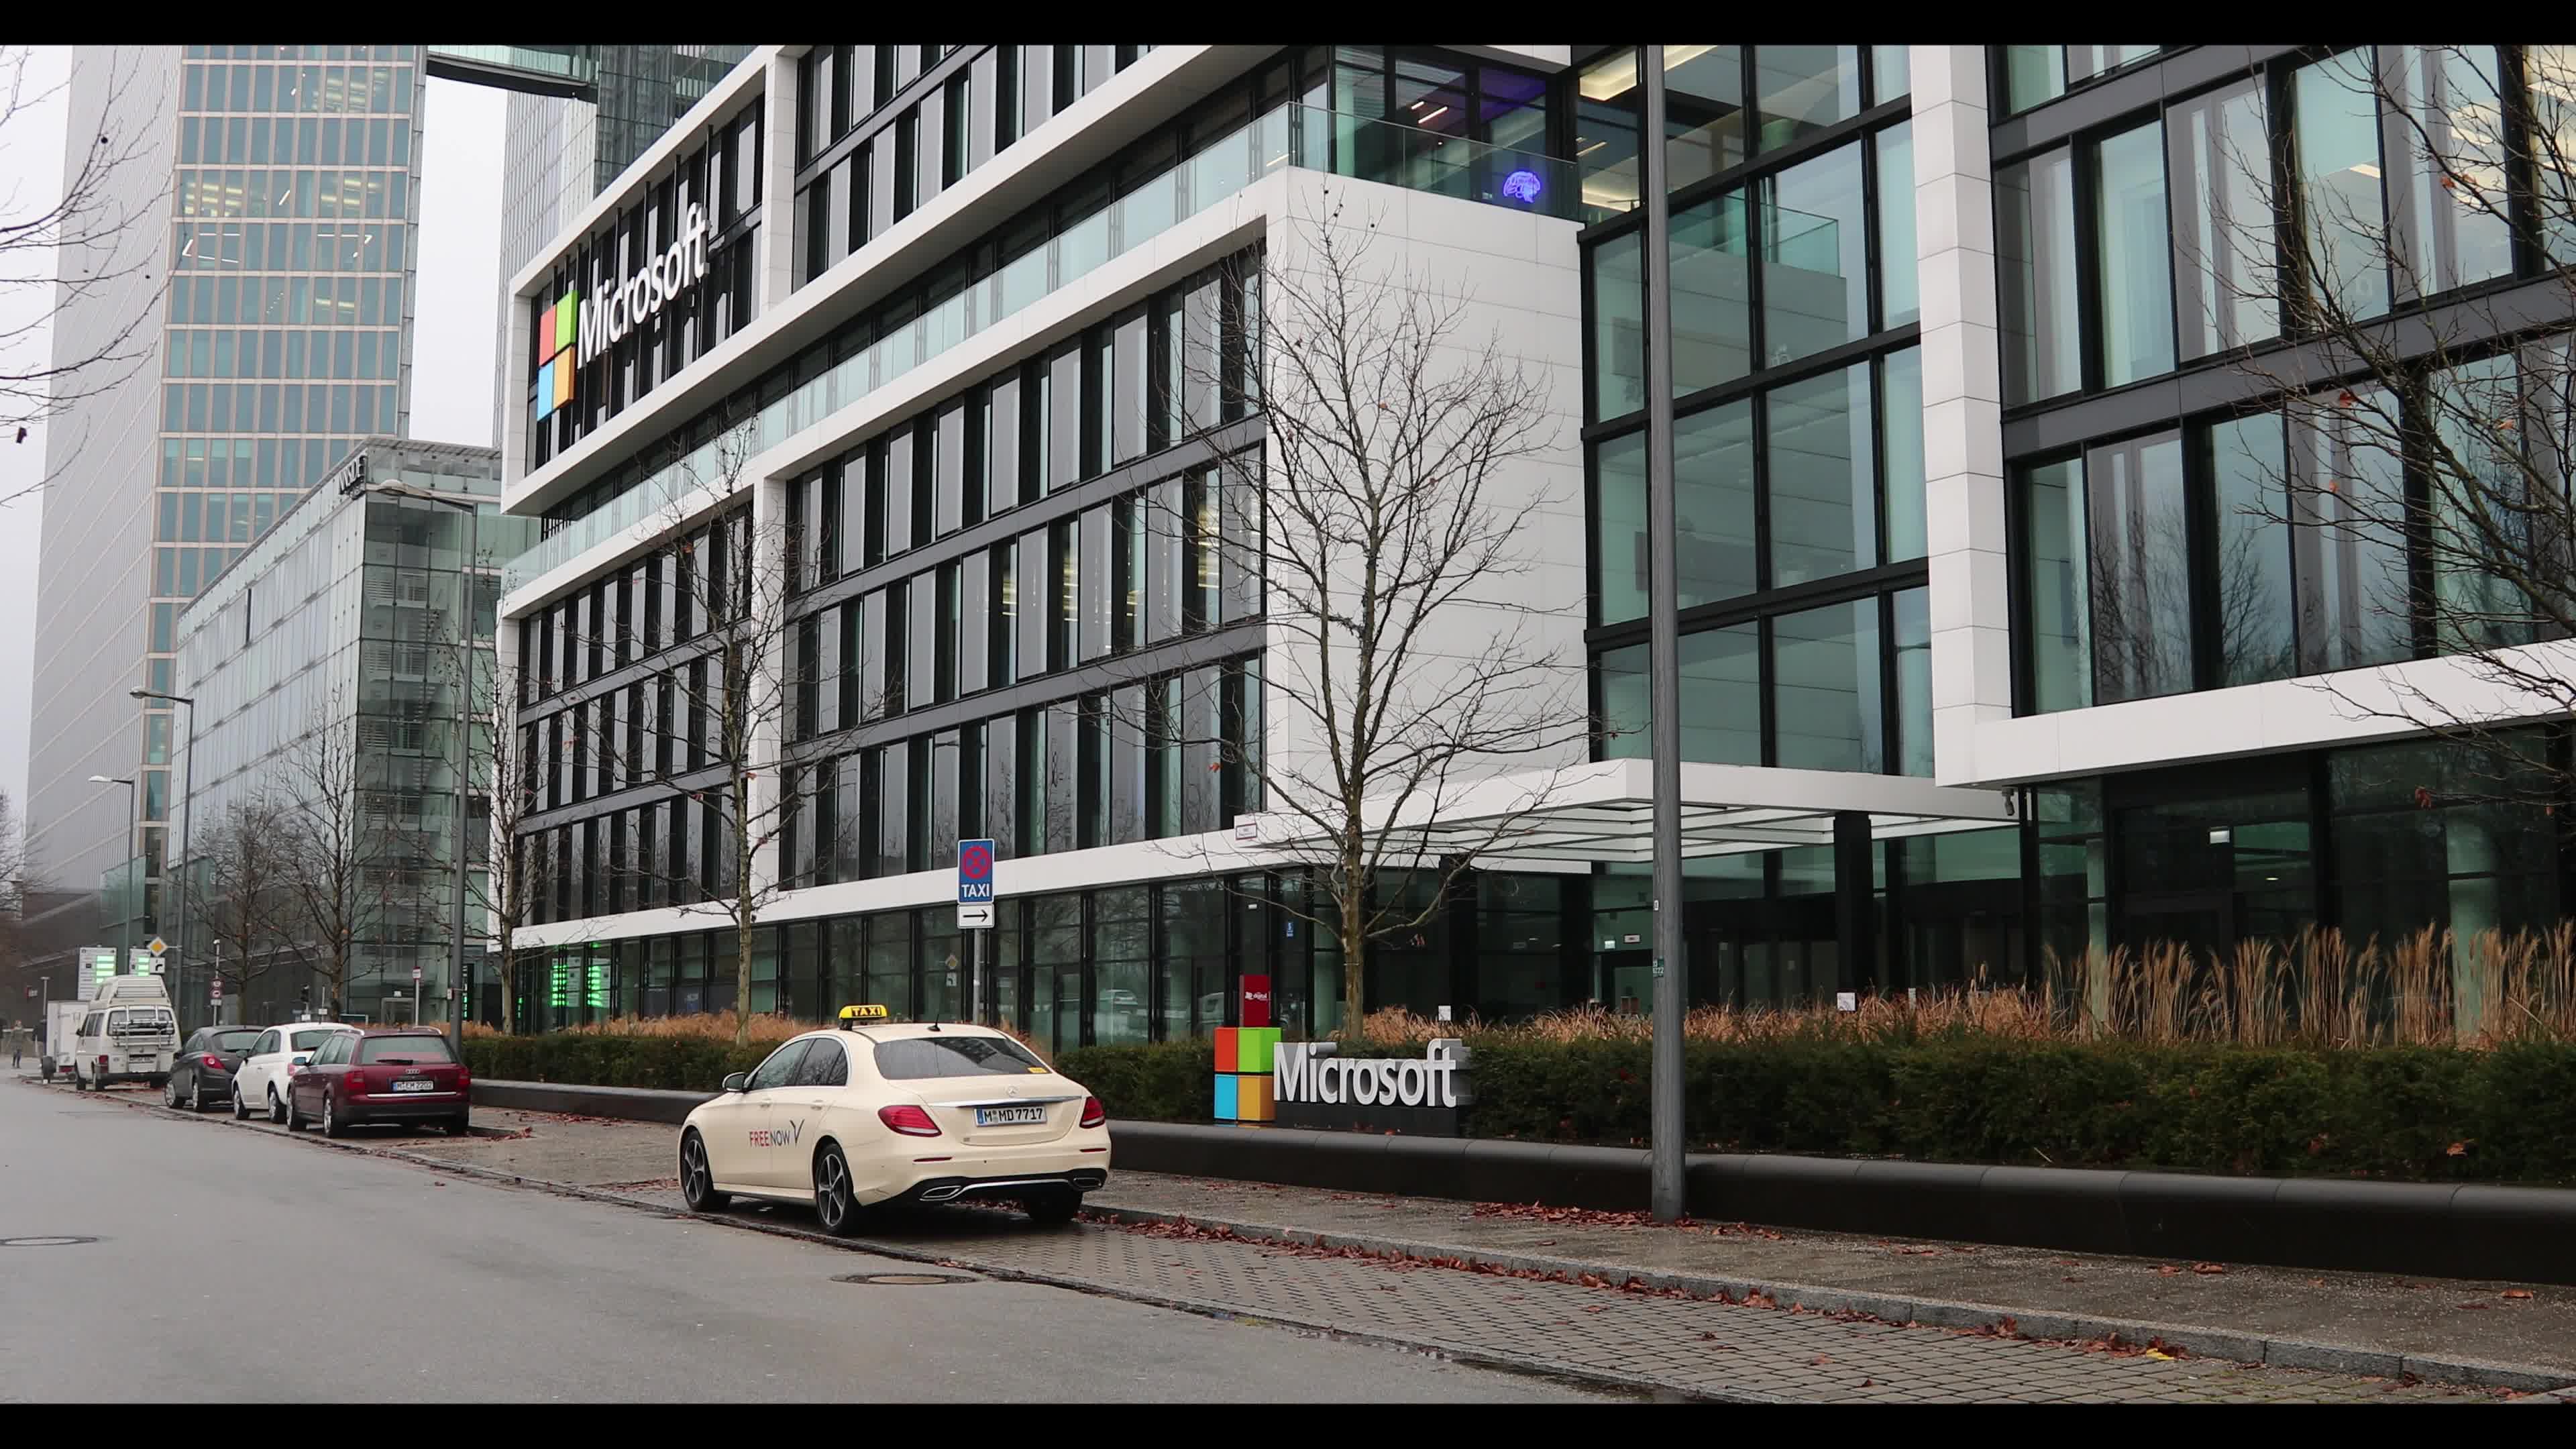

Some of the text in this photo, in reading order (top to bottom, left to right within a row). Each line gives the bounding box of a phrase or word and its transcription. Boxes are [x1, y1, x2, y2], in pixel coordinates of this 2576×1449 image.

[577, 202, 710, 370] Microsoft
[961, 883, 989, 898] TAXI
[852, 1007, 881, 1016] TAXI
[1273, 1038, 1457, 1108] Microsoft
[1015, 1108, 1043, 1120] 7717
